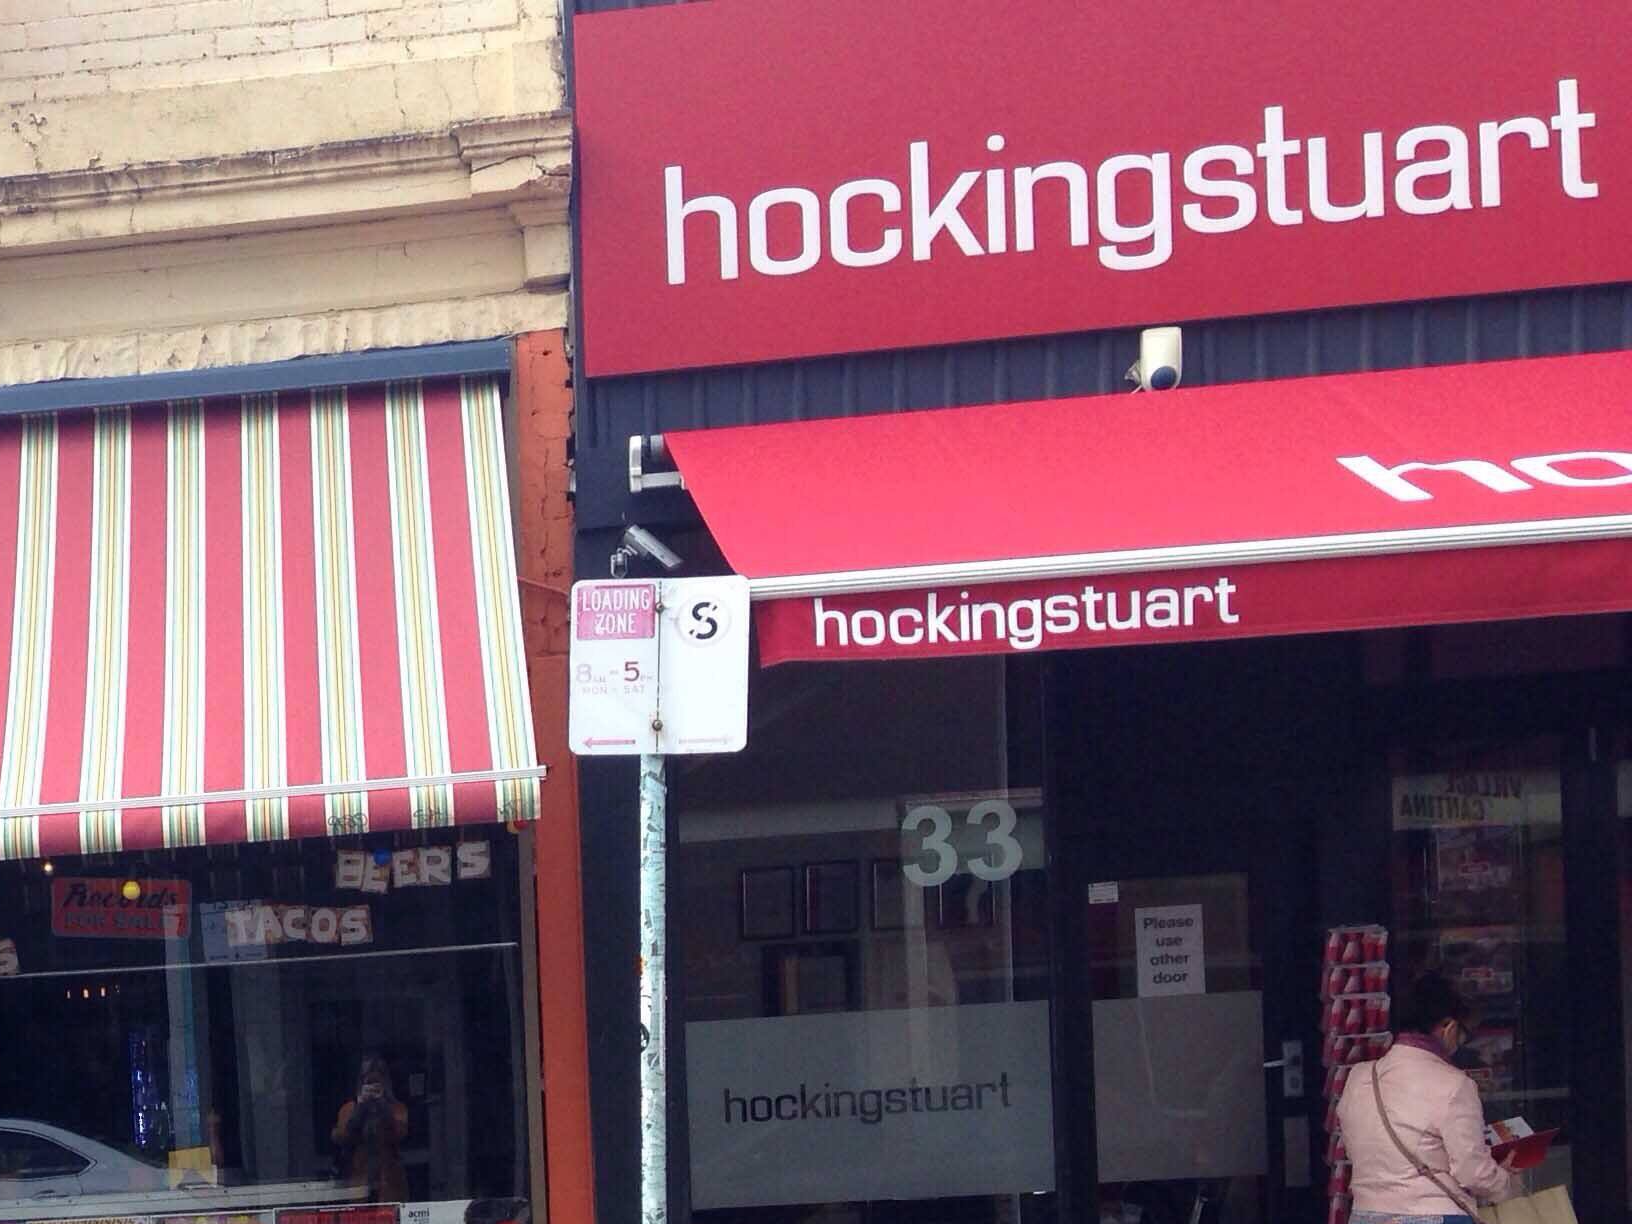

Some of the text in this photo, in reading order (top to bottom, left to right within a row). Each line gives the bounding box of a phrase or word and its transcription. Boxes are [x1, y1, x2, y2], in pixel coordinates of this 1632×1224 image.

[665, 78, 1600, 286] hockingstuart
[582, 590, 651, 612] LOADING
[814, 577, 1239, 650] hockingstuart
[594, 613, 637, 635] ZONE
[901, 799, 1024, 888] 33
[336, 840, 490, 894] BEERS
[225, 904, 371, 946] TACOS
[1143, 917, 1194, 930] Please
[1155, 936, 1183, 947] use
[1150, 953, 1190, 966] other
[1152, 971, 1188, 984] door
[723, 1071, 1011, 1125] hockingstuart
